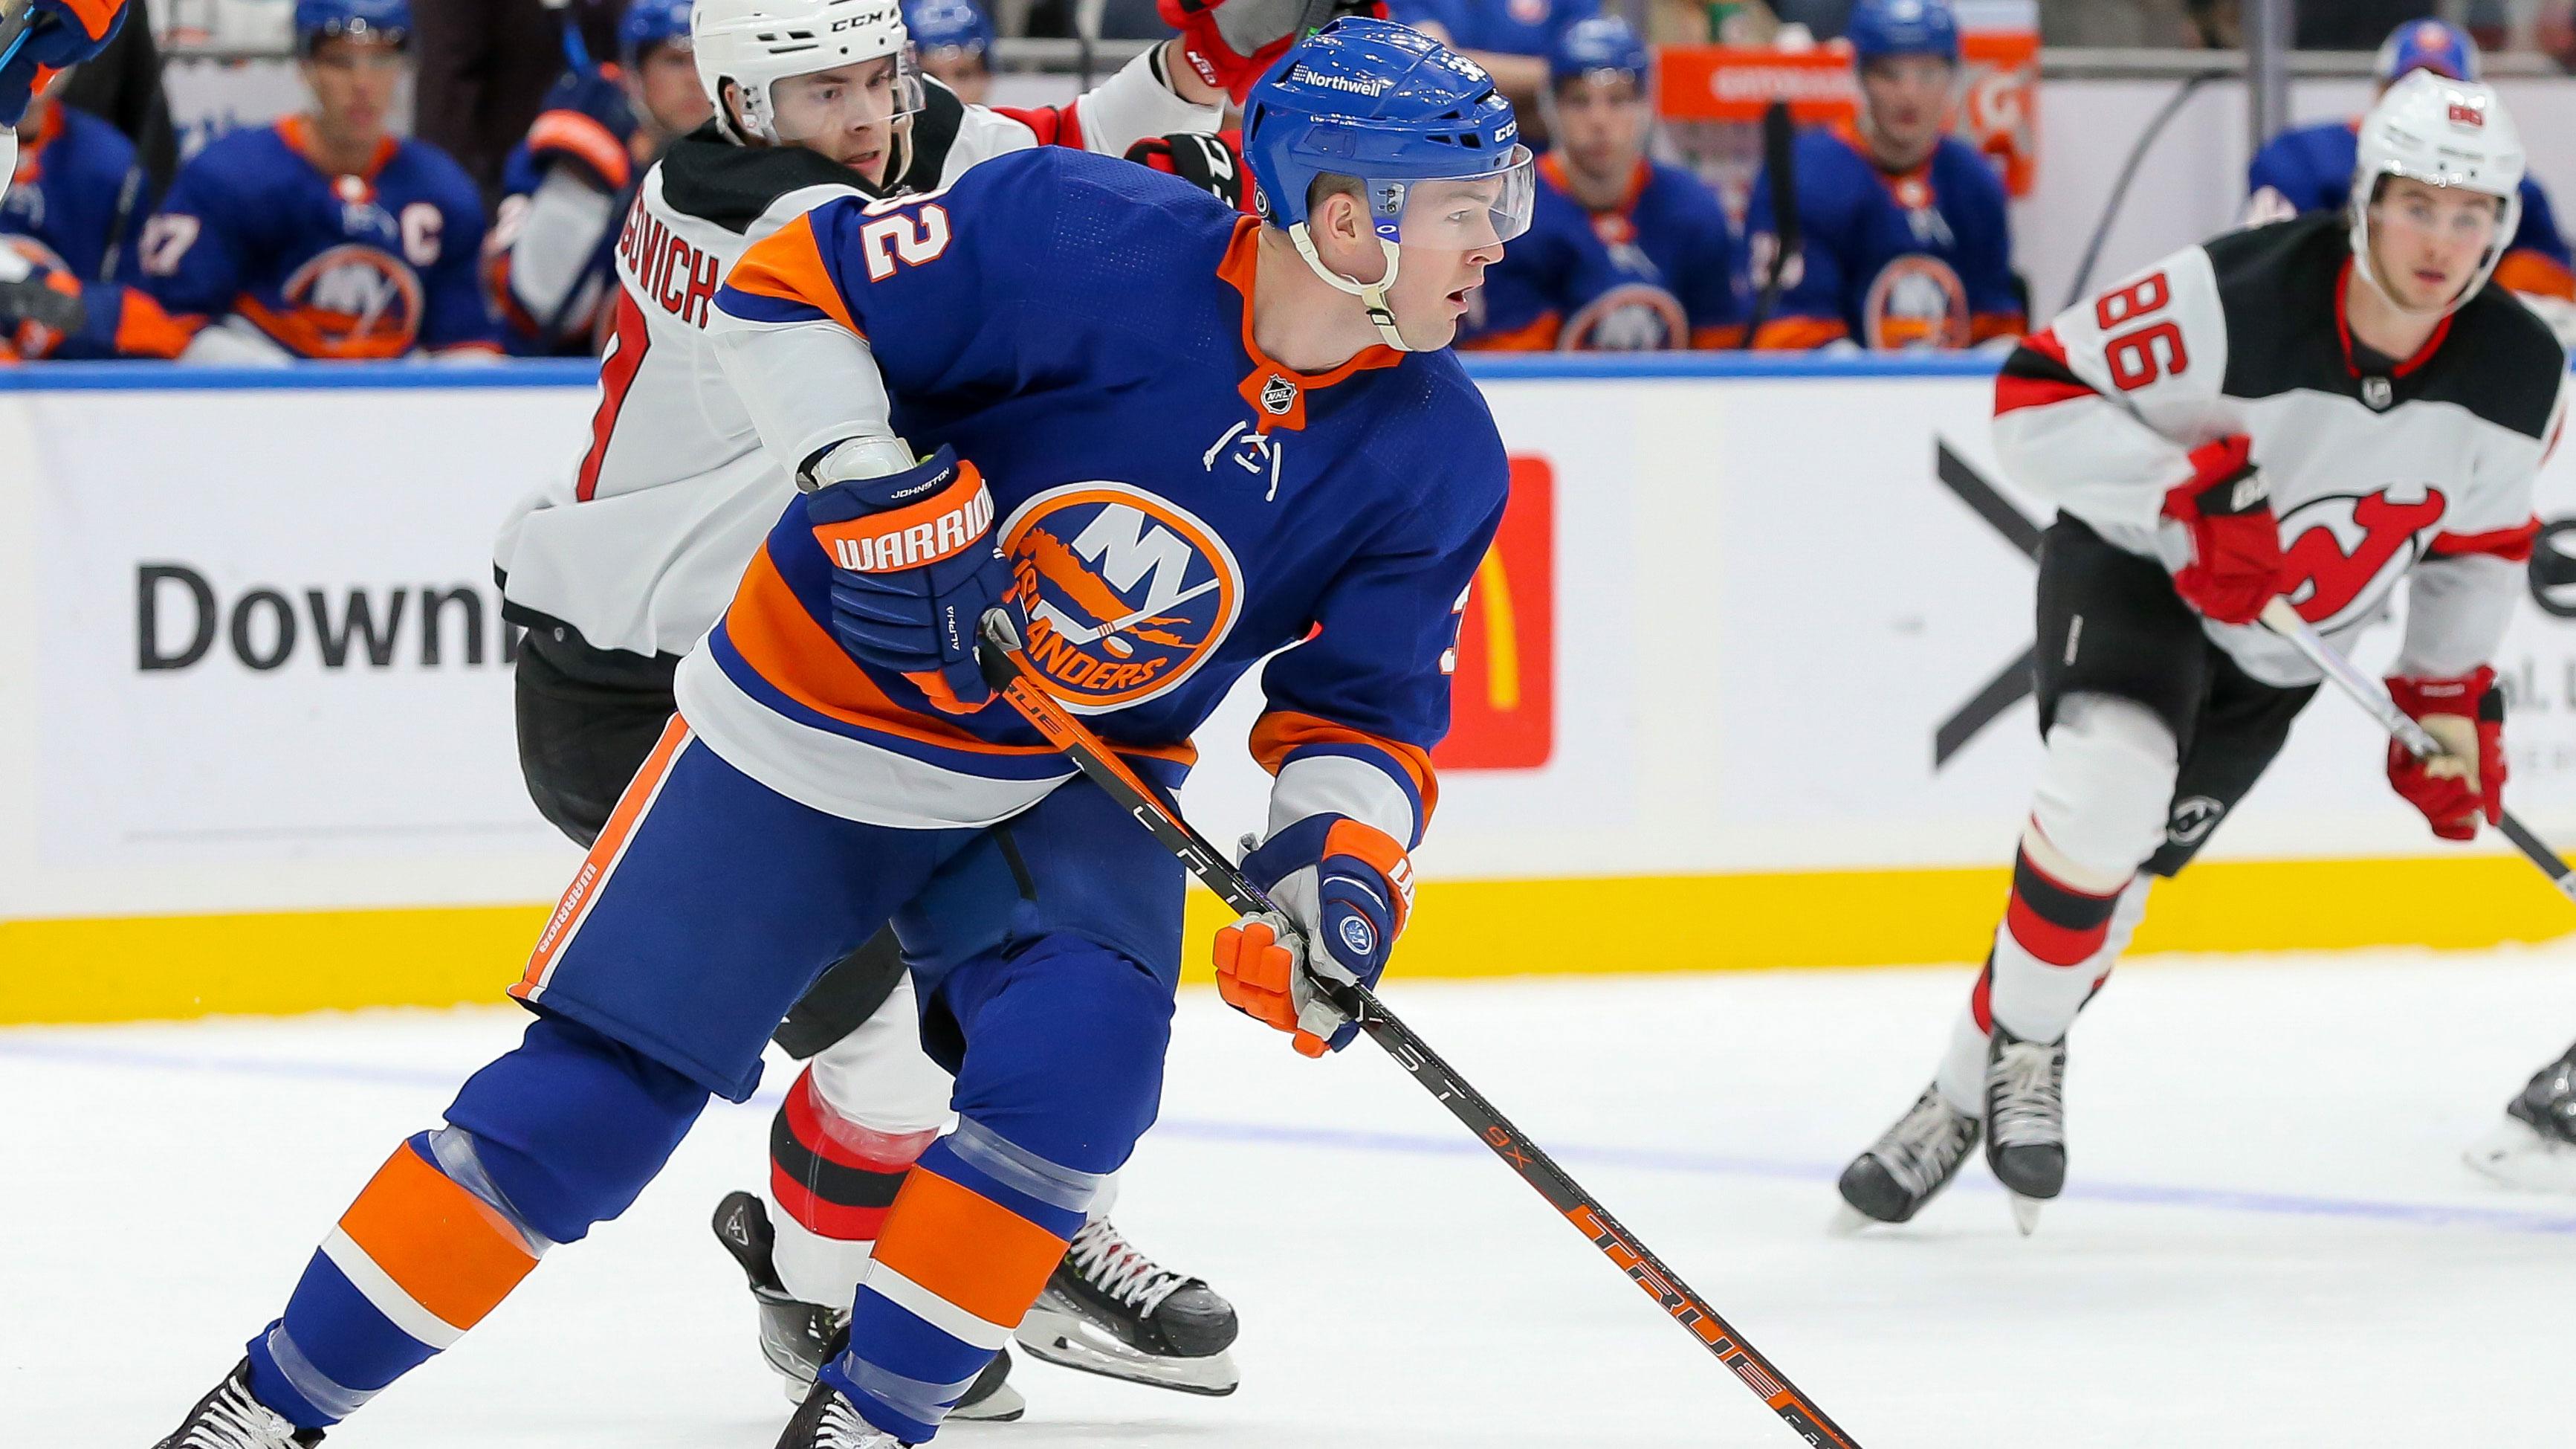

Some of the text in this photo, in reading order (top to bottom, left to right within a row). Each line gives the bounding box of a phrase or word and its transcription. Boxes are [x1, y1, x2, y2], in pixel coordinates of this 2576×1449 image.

[832, 10, 882, 32] CCM
[1305, 71, 1381, 97] Northwell
[400, 202, 444, 267] C
[2096, 272, 2189, 392] 86
[1266, 390, 1288, 401] NHL
[891, 467, 951, 499] JOHNSTON
[945, 605, 960, 651] ALPHA
[539, 862, 598, 953] WARRIOR
[1483, 1126, 1534, 1169] 9X
[1586, 1213, 1784, 1401] TRUE
